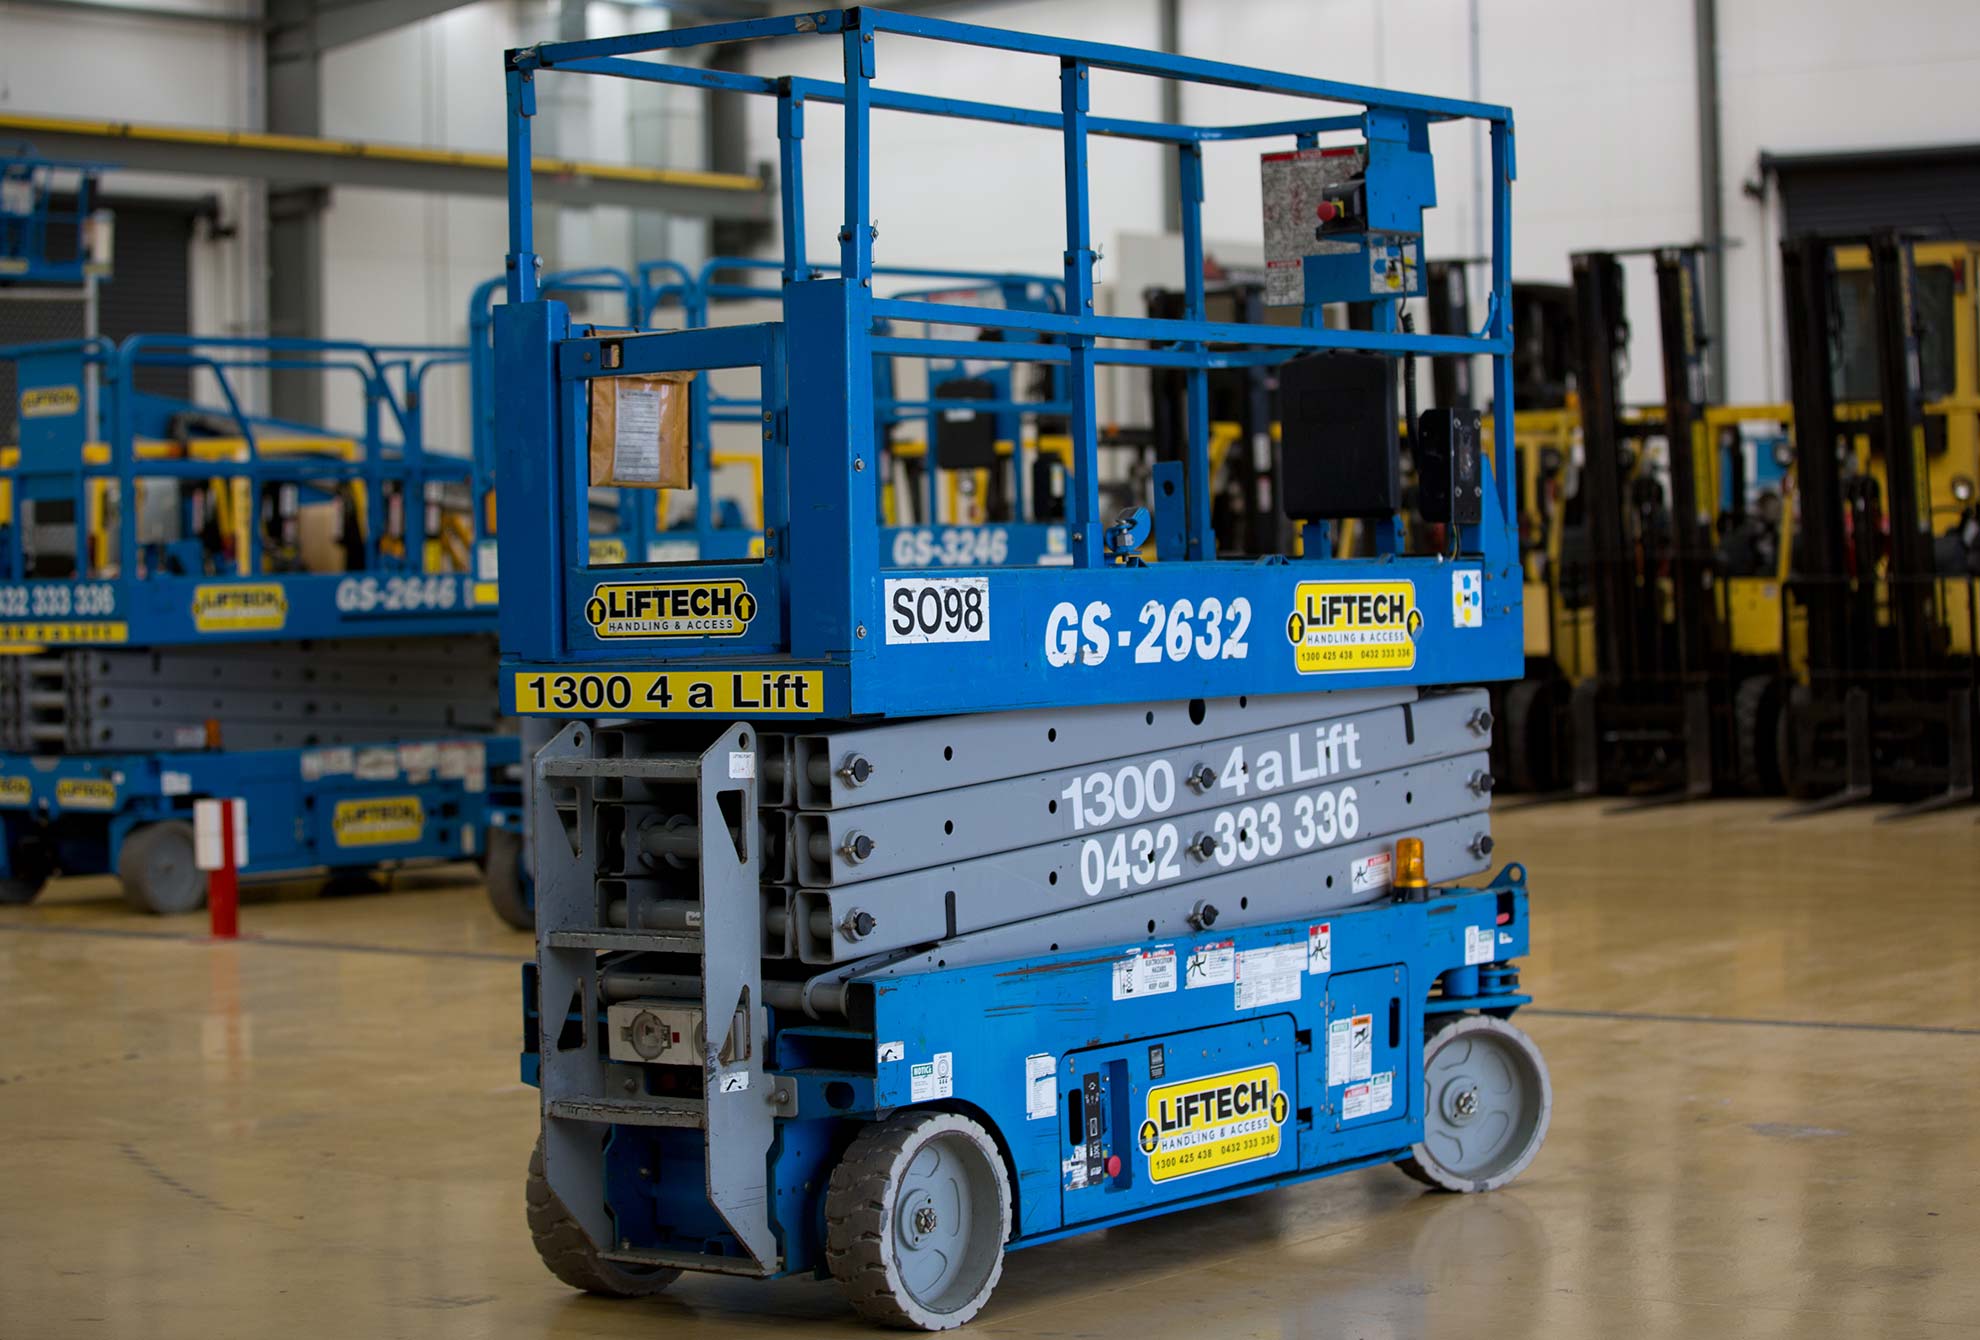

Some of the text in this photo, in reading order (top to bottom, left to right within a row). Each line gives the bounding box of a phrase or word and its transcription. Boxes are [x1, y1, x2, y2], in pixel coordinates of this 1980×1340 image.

[893, 528, 1008, 566] GS-3246
[608, 619, 733, 631] HANDLING & ACCESS
[1307, 631, 1405, 645] HANDLING & ACCESS
[1302, 648, 1411, 662] 1300 425 438 0432 333 336
[528, 673, 809, 710] 1300 4 a Lift
[1061, 723, 1362, 830] 1300 4 a Lift
[1080, 786, 1360, 897] 0432 333 336
[1156, 1134, 1275, 1170] 1300 425 438 0432 333 336
[1162, 1119, 1269, 1151] HANDLING & ACCESS
